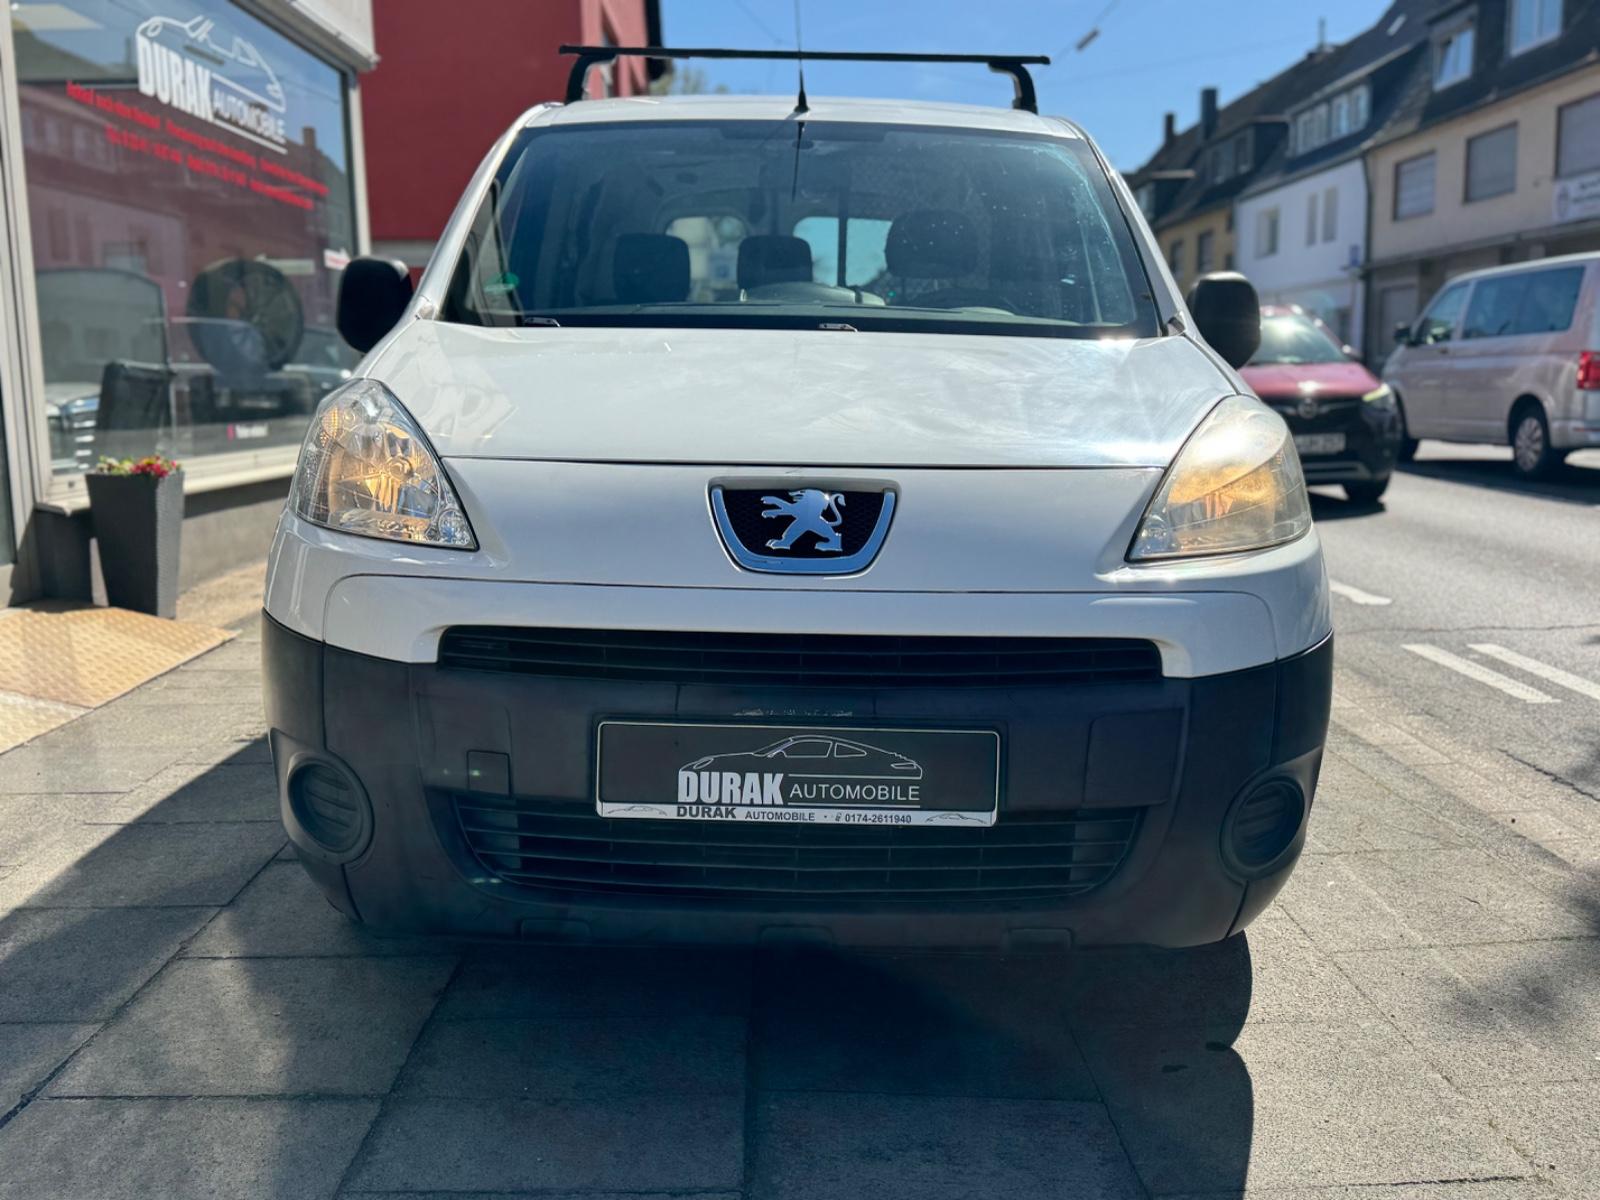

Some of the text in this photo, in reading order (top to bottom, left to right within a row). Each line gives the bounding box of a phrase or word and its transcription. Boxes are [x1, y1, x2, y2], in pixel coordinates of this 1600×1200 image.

[137, 36, 213, 122] DURAK
[213, 89, 286, 144] AUTOMOBILE
[678, 770, 920, 805] DURAK AUTOMOBILE
[676, 806, 912, 824] DURAK AUTOMOBILE 0174-2611940
